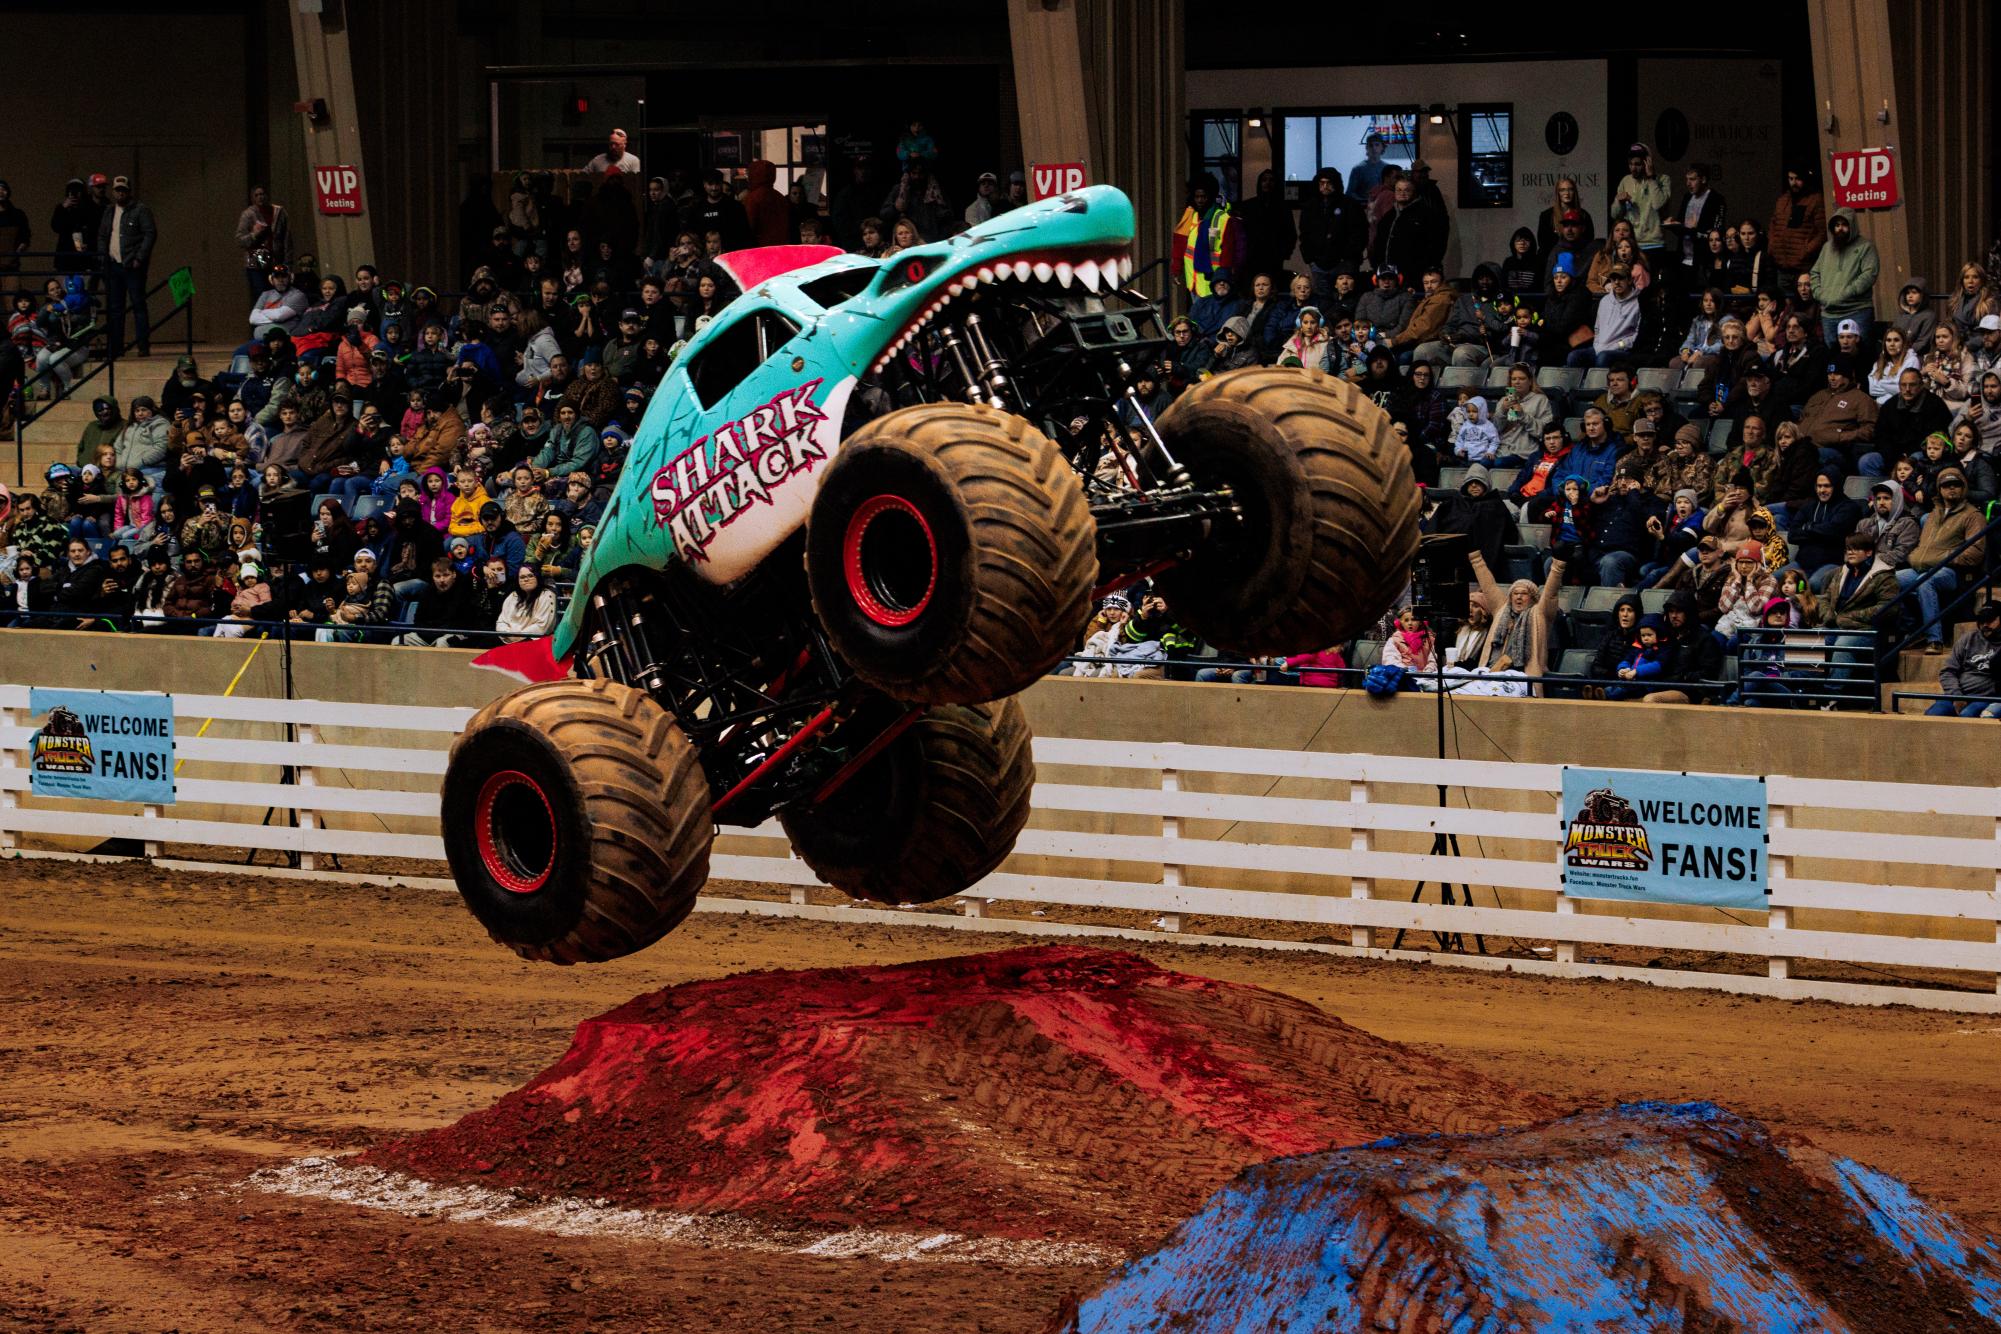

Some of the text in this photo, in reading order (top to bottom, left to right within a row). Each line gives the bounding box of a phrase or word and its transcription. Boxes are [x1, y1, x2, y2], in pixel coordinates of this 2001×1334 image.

[317, 171, 357, 194] VIP
[1036, 168, 1083, 195] VIP
[1835, 155, 1890, 187] VIP
[326, 198, 355, 209] Seating
[1845, 190, 1887, 203] Seating
[651, 380, 825, 522] SHARK
[669, 421, 827, 563] ATTACK
[85, 714, 169, 738] WELCOME
[35, 735, 93, 760] MONSTER
[101, 750, 167, 781] FANS!
[1639, 799, 1761, 829] WELCOME
[1566, 823, 1650, 856] MONSTER
[1577, 842, 1639, 861] TRUCK
[1580, 858, 1636, 868] WARS
[1661, 843, 1758, 882] FANS!
[1569, 878, 1594, 887] Facebook:
[1596, 880, 1617, 888] Monster
[1618, 882, 1632, 890] Truck
